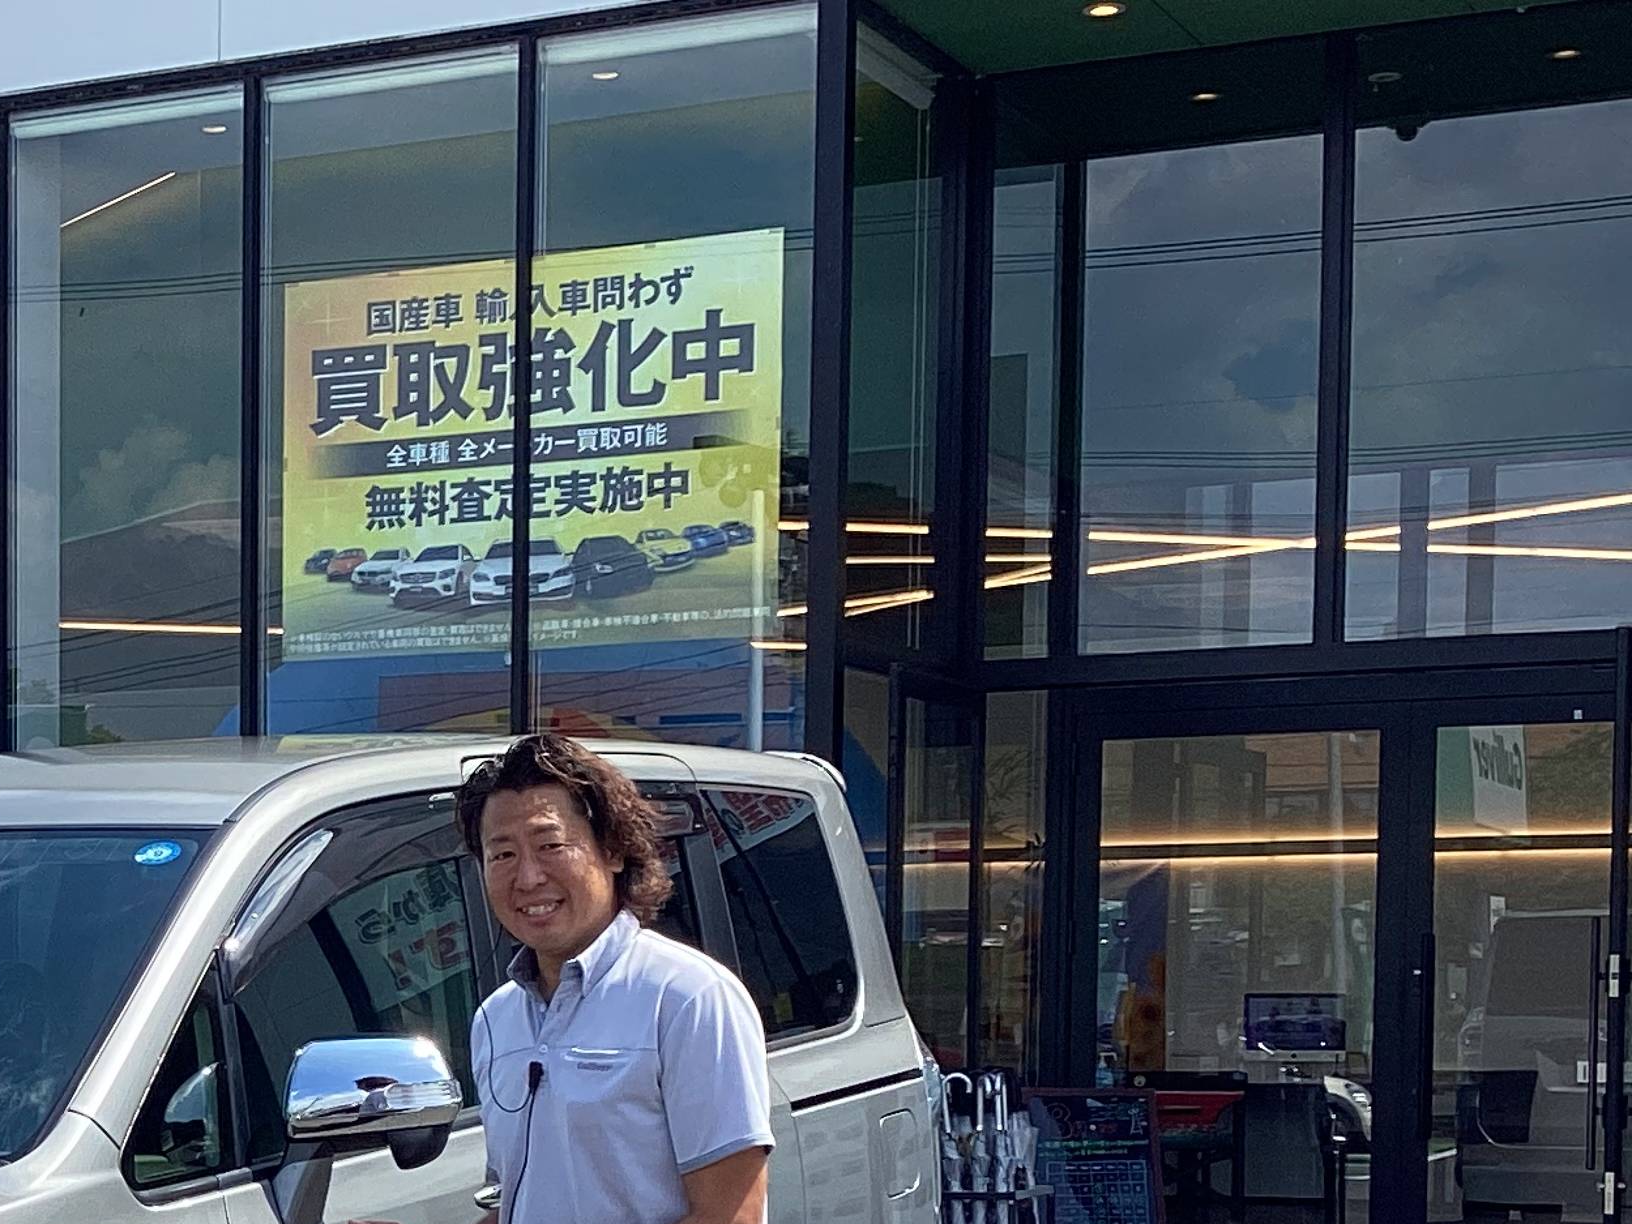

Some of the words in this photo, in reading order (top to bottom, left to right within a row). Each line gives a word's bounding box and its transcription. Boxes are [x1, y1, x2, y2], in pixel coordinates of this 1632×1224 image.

[367, 292, 463, 337] 国産車
[475, 266, 695, 324] 輸入車問わず
[309, 308, 756, 434] 買取強化中
[386, 440, 450, 467] 全車種
[458, 422, 668, 463] 全メーカー買取可能
[365, 462, 691, 531] 無料査定実施中
